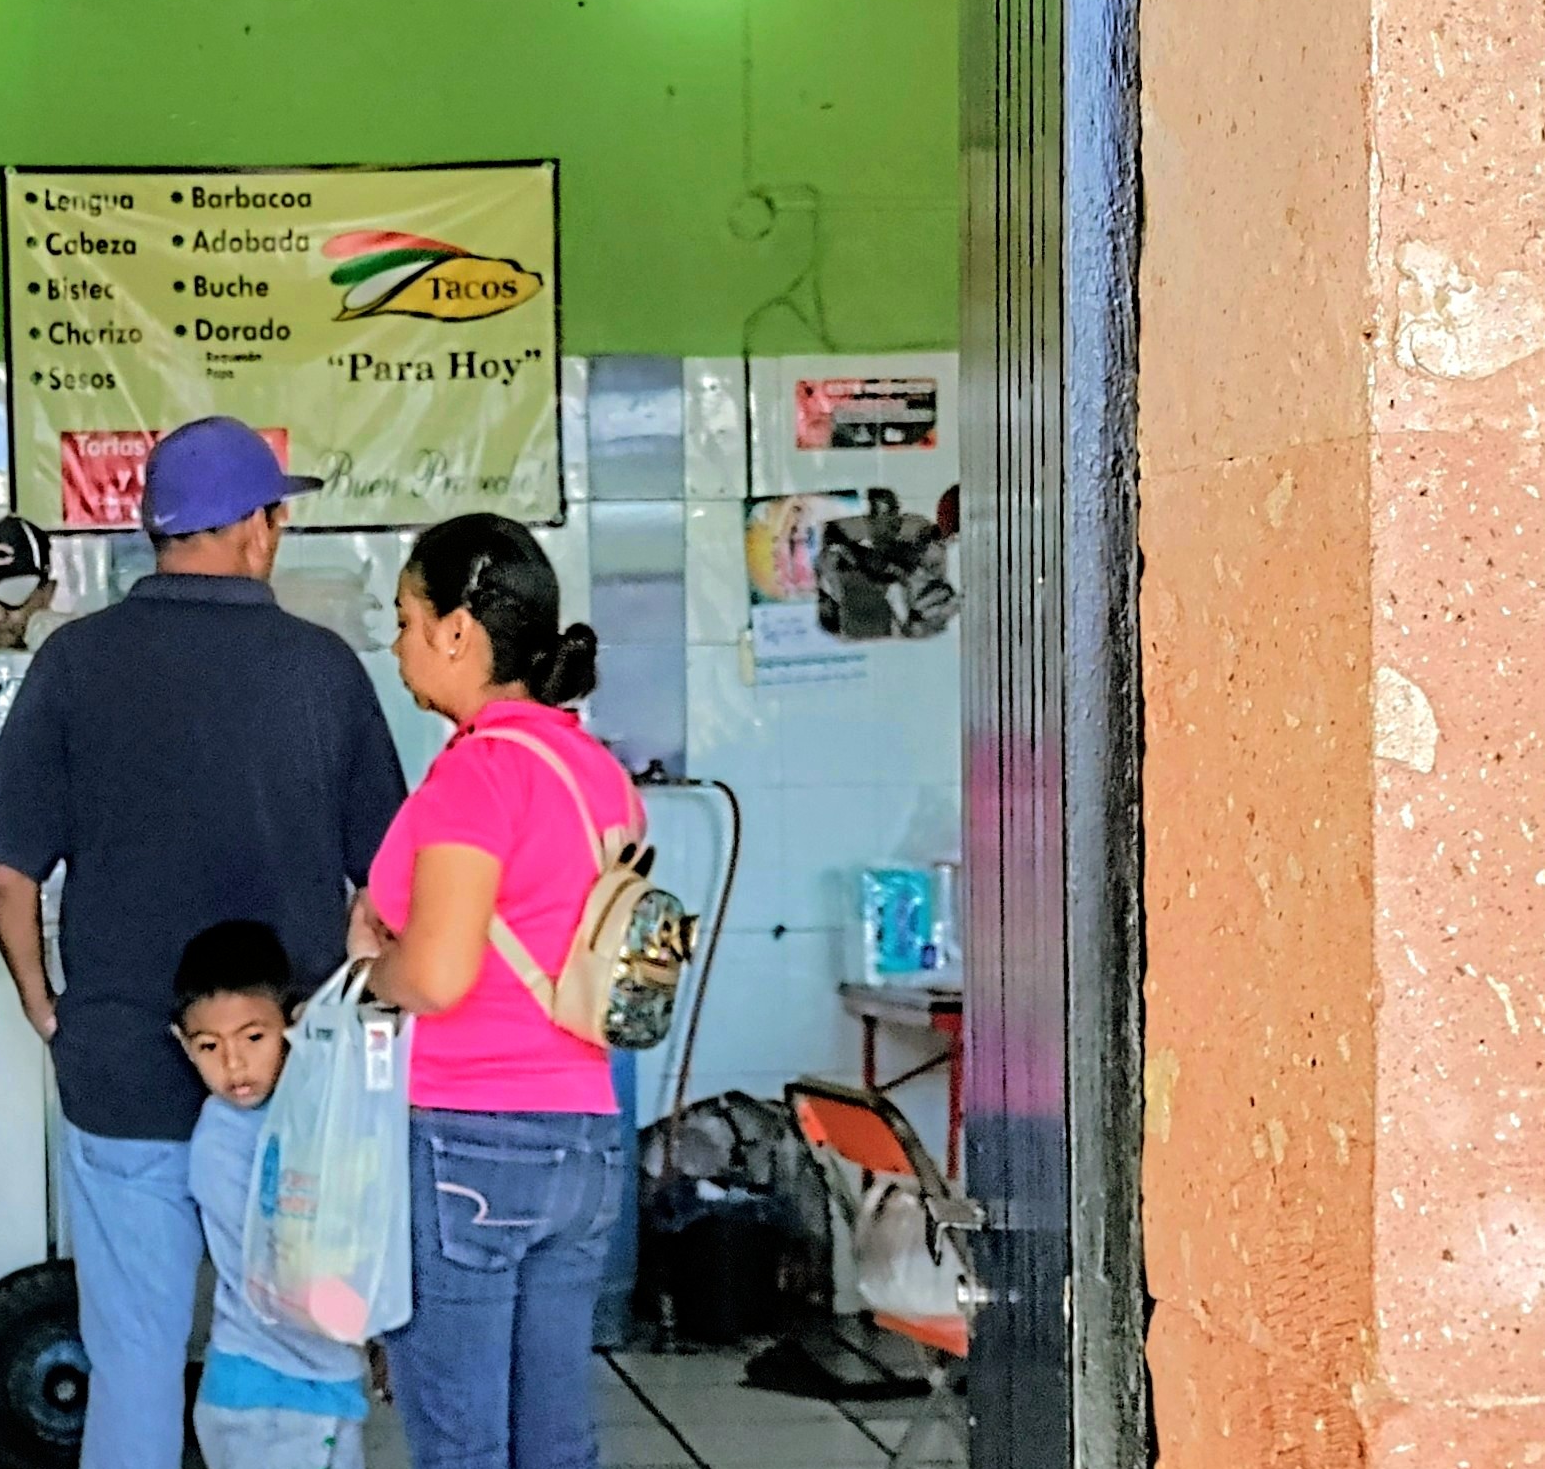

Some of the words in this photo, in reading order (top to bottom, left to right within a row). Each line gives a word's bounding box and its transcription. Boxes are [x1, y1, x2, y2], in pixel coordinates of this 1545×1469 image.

[45, 189, 133, 217] Lengua
[192, 186, 312, 208] Barbacoa
[45, 231, 137, 256] Cabeza
[192, 228, 309, 253] Adobada
[47, 277, 115, 300] Bistec
[194, 275, 269, 297] Buche
[426, 277, 519, 300] Tacos
[48, 320, 143, 345] Chorizo
[195, 317, 291, 341] Dorado
[49, 366, 116, 390] Sesos
